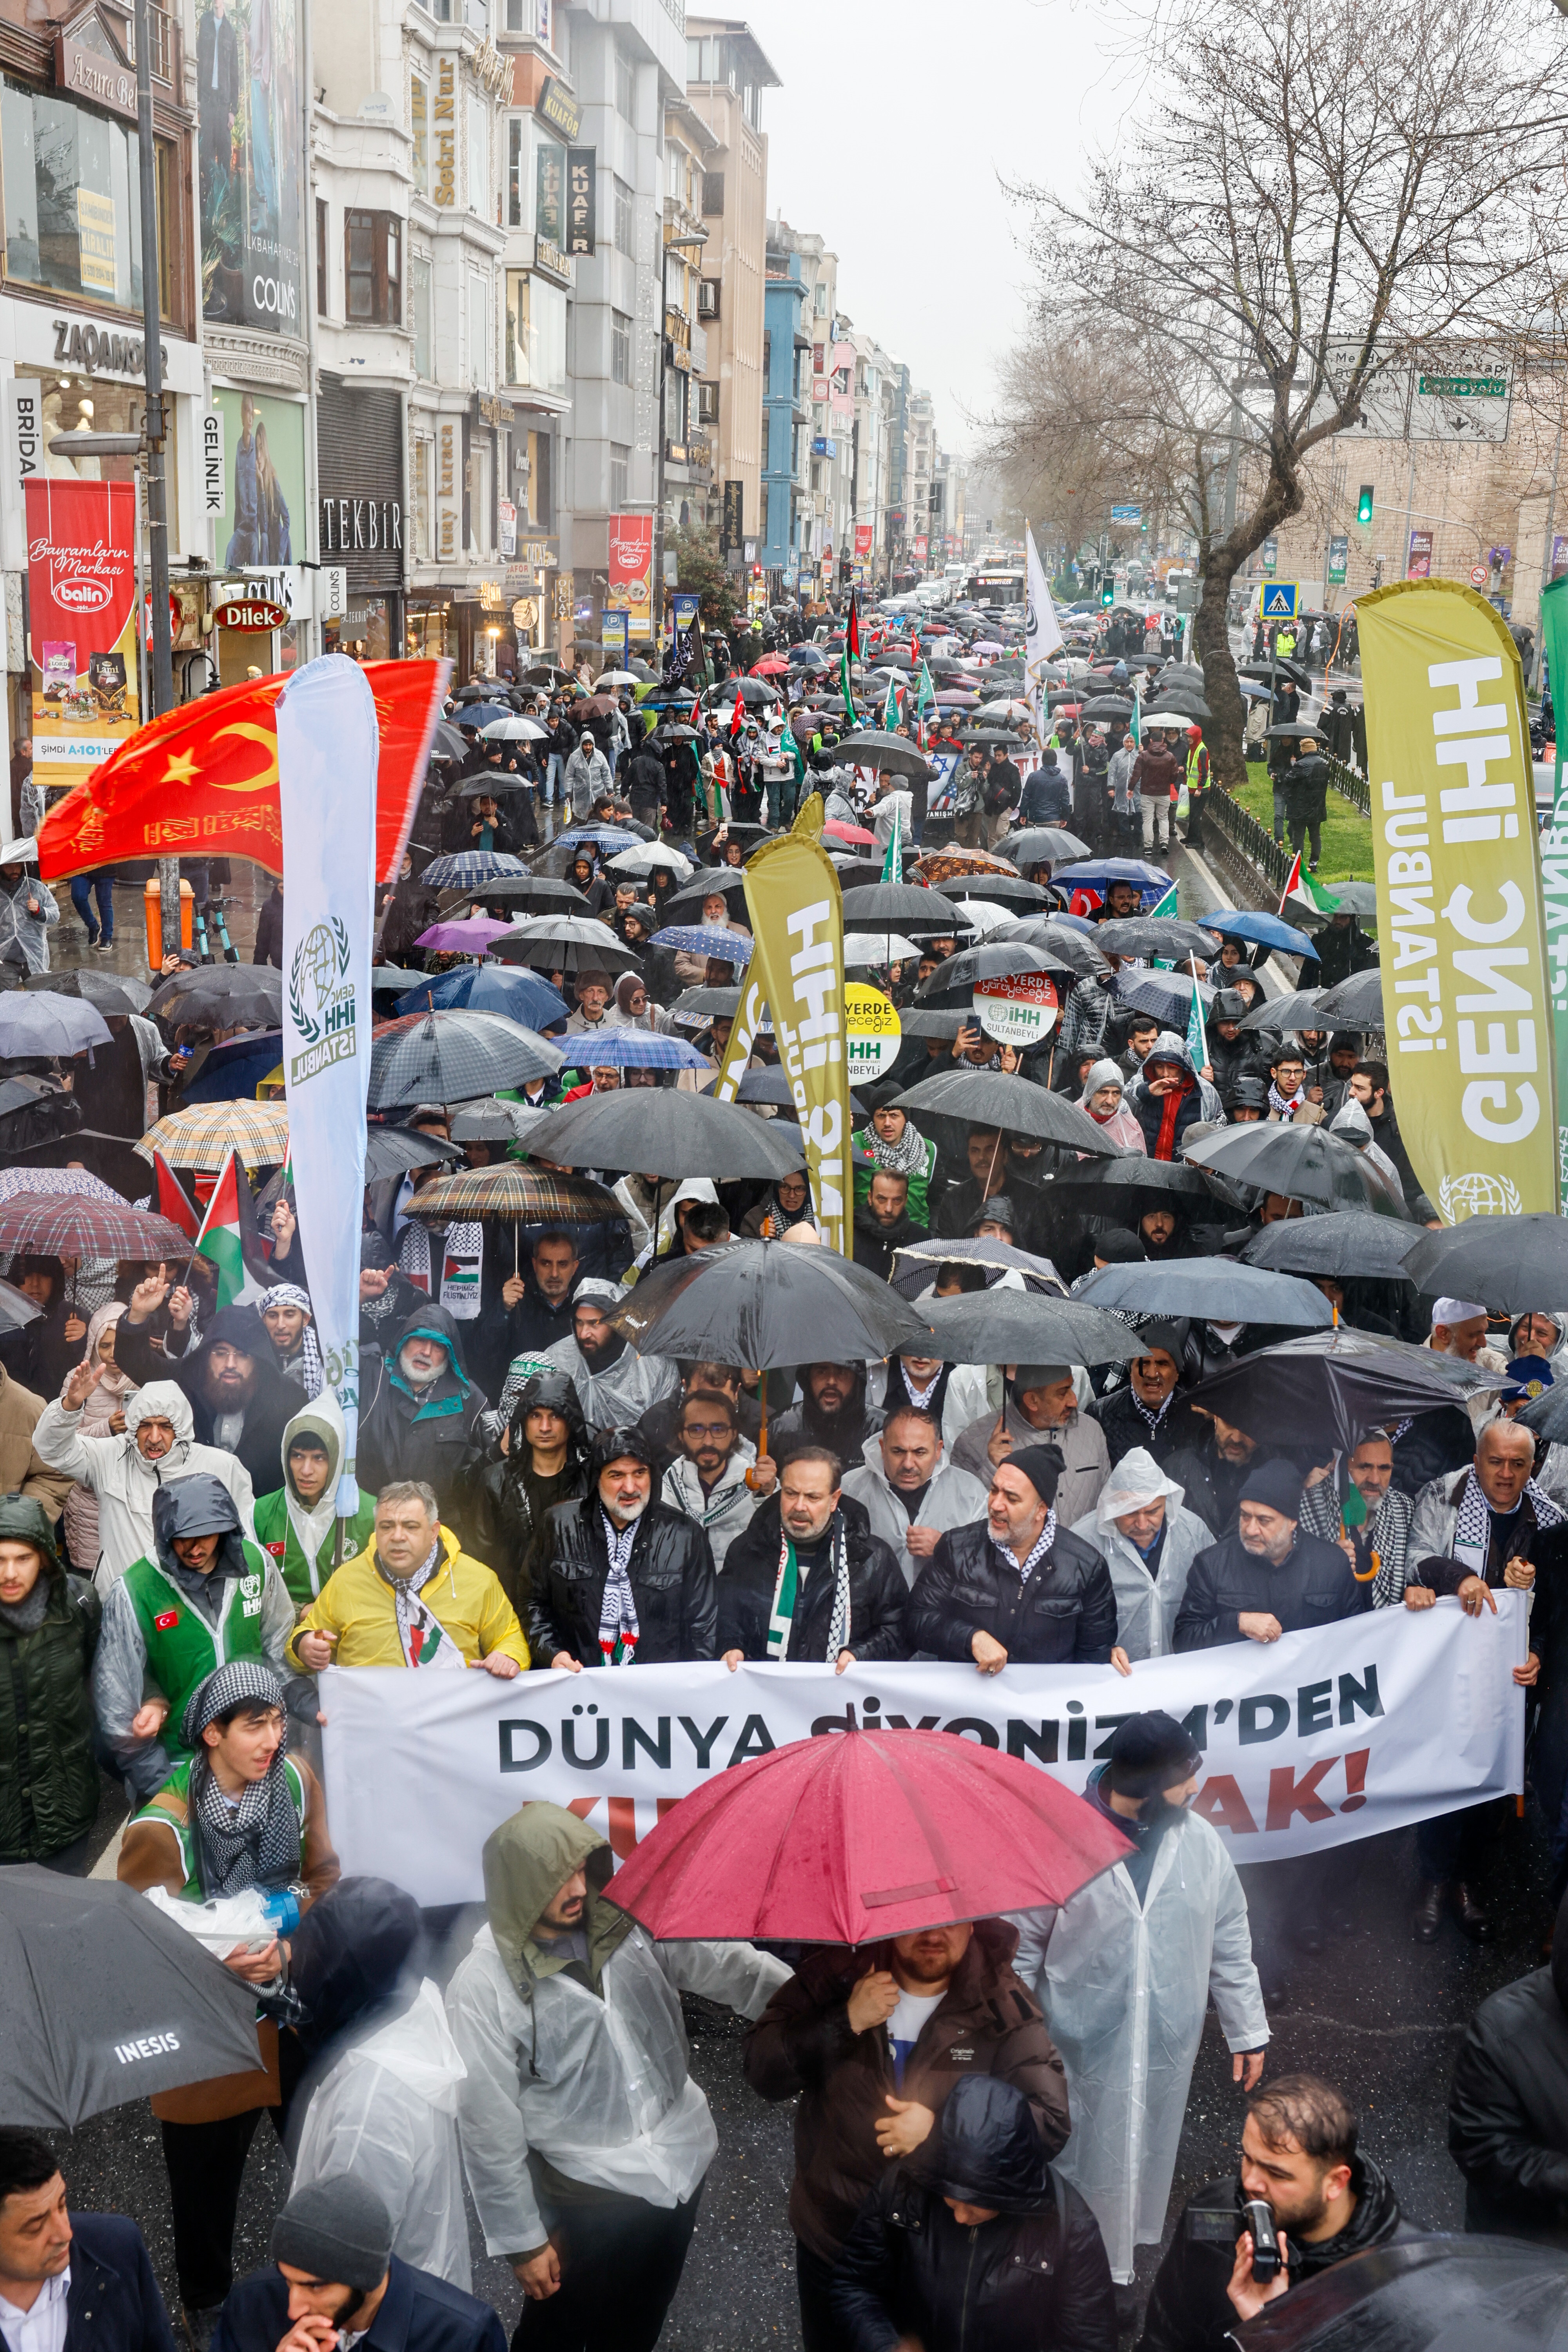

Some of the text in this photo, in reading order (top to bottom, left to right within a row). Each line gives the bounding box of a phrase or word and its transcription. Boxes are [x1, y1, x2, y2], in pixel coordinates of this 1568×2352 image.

[69, 54, 114, 100] Azura
[435, 57, 455, 205] Setri Nur
[544, 95, 579, 137] KUAFÖR
[572, 166, 589, 251] KUAFR
[253, 275, 296, 319] COLIN'S
[53, 320, 169, 380] ZAQAMOR
[17, 397, 36, 490] BRİDA
[204, 416, 221, 510] GELİNLİK
[324, 498, 402, 550] TEKBİR
[30, 538, 130, 562] Bayramların
[610, 537, 650, 548] Bayramların
[620, 545, 648, 553] Markası
[54, 557, 124, 577] Markası
[61, 585, 103, 603] balin
[329, 571, 339, 611] COLIN'S
[558, 579, 567, 617] OLCAY
[227, 607, 277, 626] Dilek
[96, 664, 119, 673] Lami
[41, 744, 65, 755] ŞİMDİ
[982, 980, 1051, 1004] yürüyeceğiz
[1013, 975, 1051, 989] YERDE
[846, 1016, 892, 1033] eceğiz
[443, 1291, 478, 1300] FİLİSTİNLİYİZ
[498, 1704, 776, 1773] DÜNYA
[114, 2031, 180, 2065] INESIS
